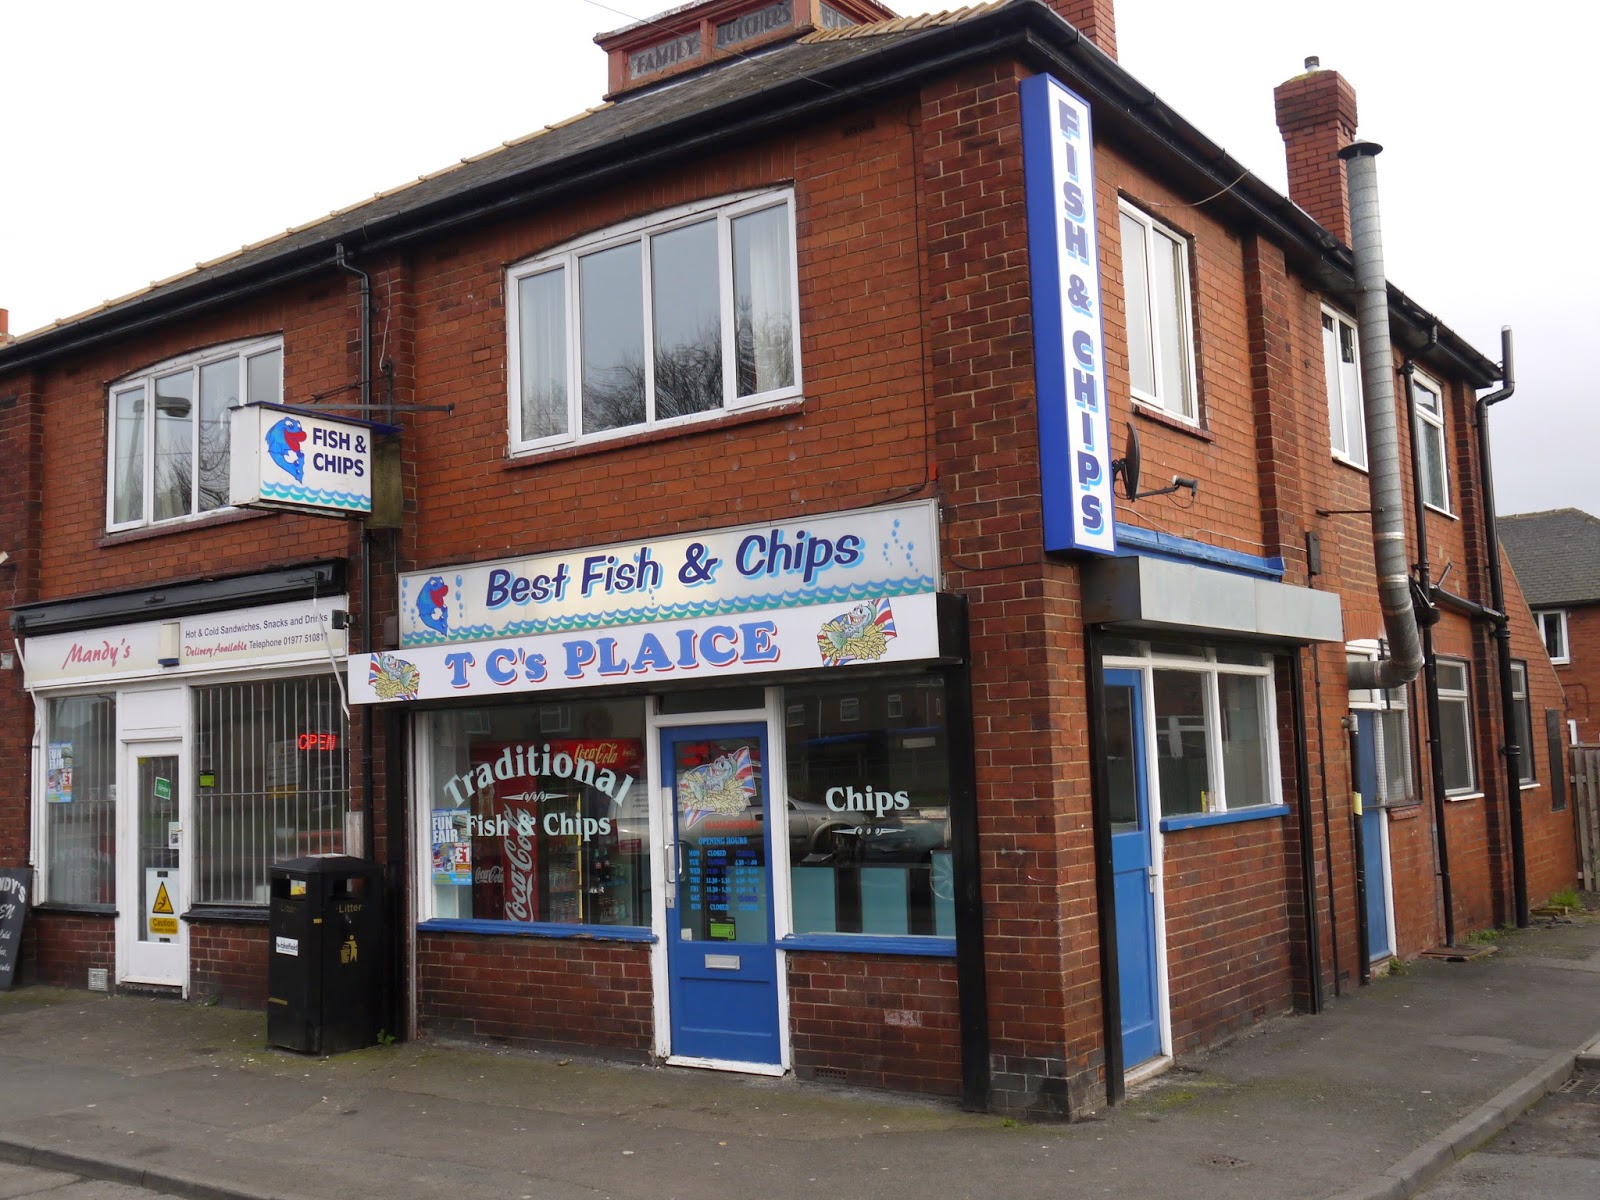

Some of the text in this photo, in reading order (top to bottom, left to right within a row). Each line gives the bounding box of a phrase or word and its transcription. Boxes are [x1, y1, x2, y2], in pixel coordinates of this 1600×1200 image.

[636, 35, 697, 73] FAMILY
[1058, 98, 1105, 535] FISH & CHIPS
[312, 427, 367, 454] FISH &
[313, 453, 364, 477] CHIPS
[485, 529, 864, 609] Best Fish & Chips
[185, 630, 197, 639] Hot
[198, 628, 203, 637] &
[204, 626, 219, 637] Cold
[220, 623, 262, 635] Sandwiches,
[263, 618, 288, 630] Snacks
[290, 616, 303, 625] and
[62, 638, 131, 670] Mandy's
[185, 645, 213, 658] Delivery
[213, 641, 247, 656] Available
[249, 637, 282, 650] Telephone
[283, 635, 303, 646] 01977
[563, 620, 781, 679] PLAICE
[298, 733, 336, 751] OPEN
[443, 743, 634, 807] Traditional
[825, 785, 910, 817] Chips
[432, 816, 453, 830] FUN
[466, 812, 611, 841] Fish & Chips
[433, 829, 458, 843] FAIR
[455, 847, 470, 863] £1
[338, 904, 362, 913] Litter
[152, 918, 174, 927] Caution
